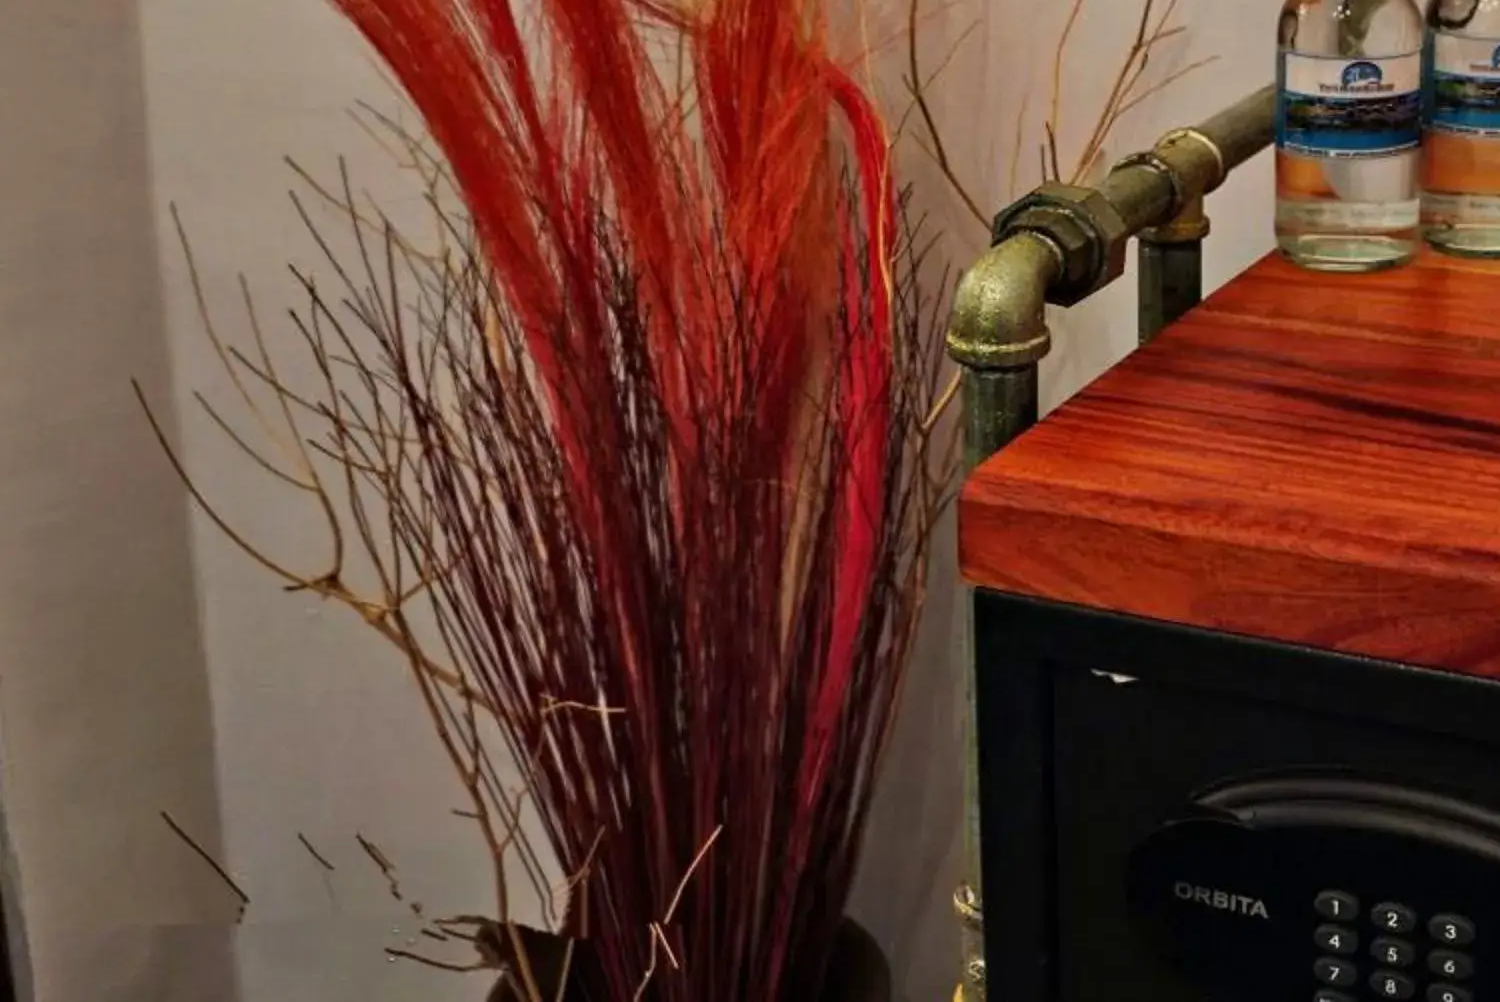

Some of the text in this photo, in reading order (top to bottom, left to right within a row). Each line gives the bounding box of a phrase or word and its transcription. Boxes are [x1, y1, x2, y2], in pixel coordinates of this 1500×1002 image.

[1174, 881, 1269, 920] ORBITA
[1331, 900, 1457, 940] 1 2 3
[1328, 933, 1455, 974] 4 5 6
[1328, 966, 1341, 981] 7
[1384, 978, 1397, 994] 8
